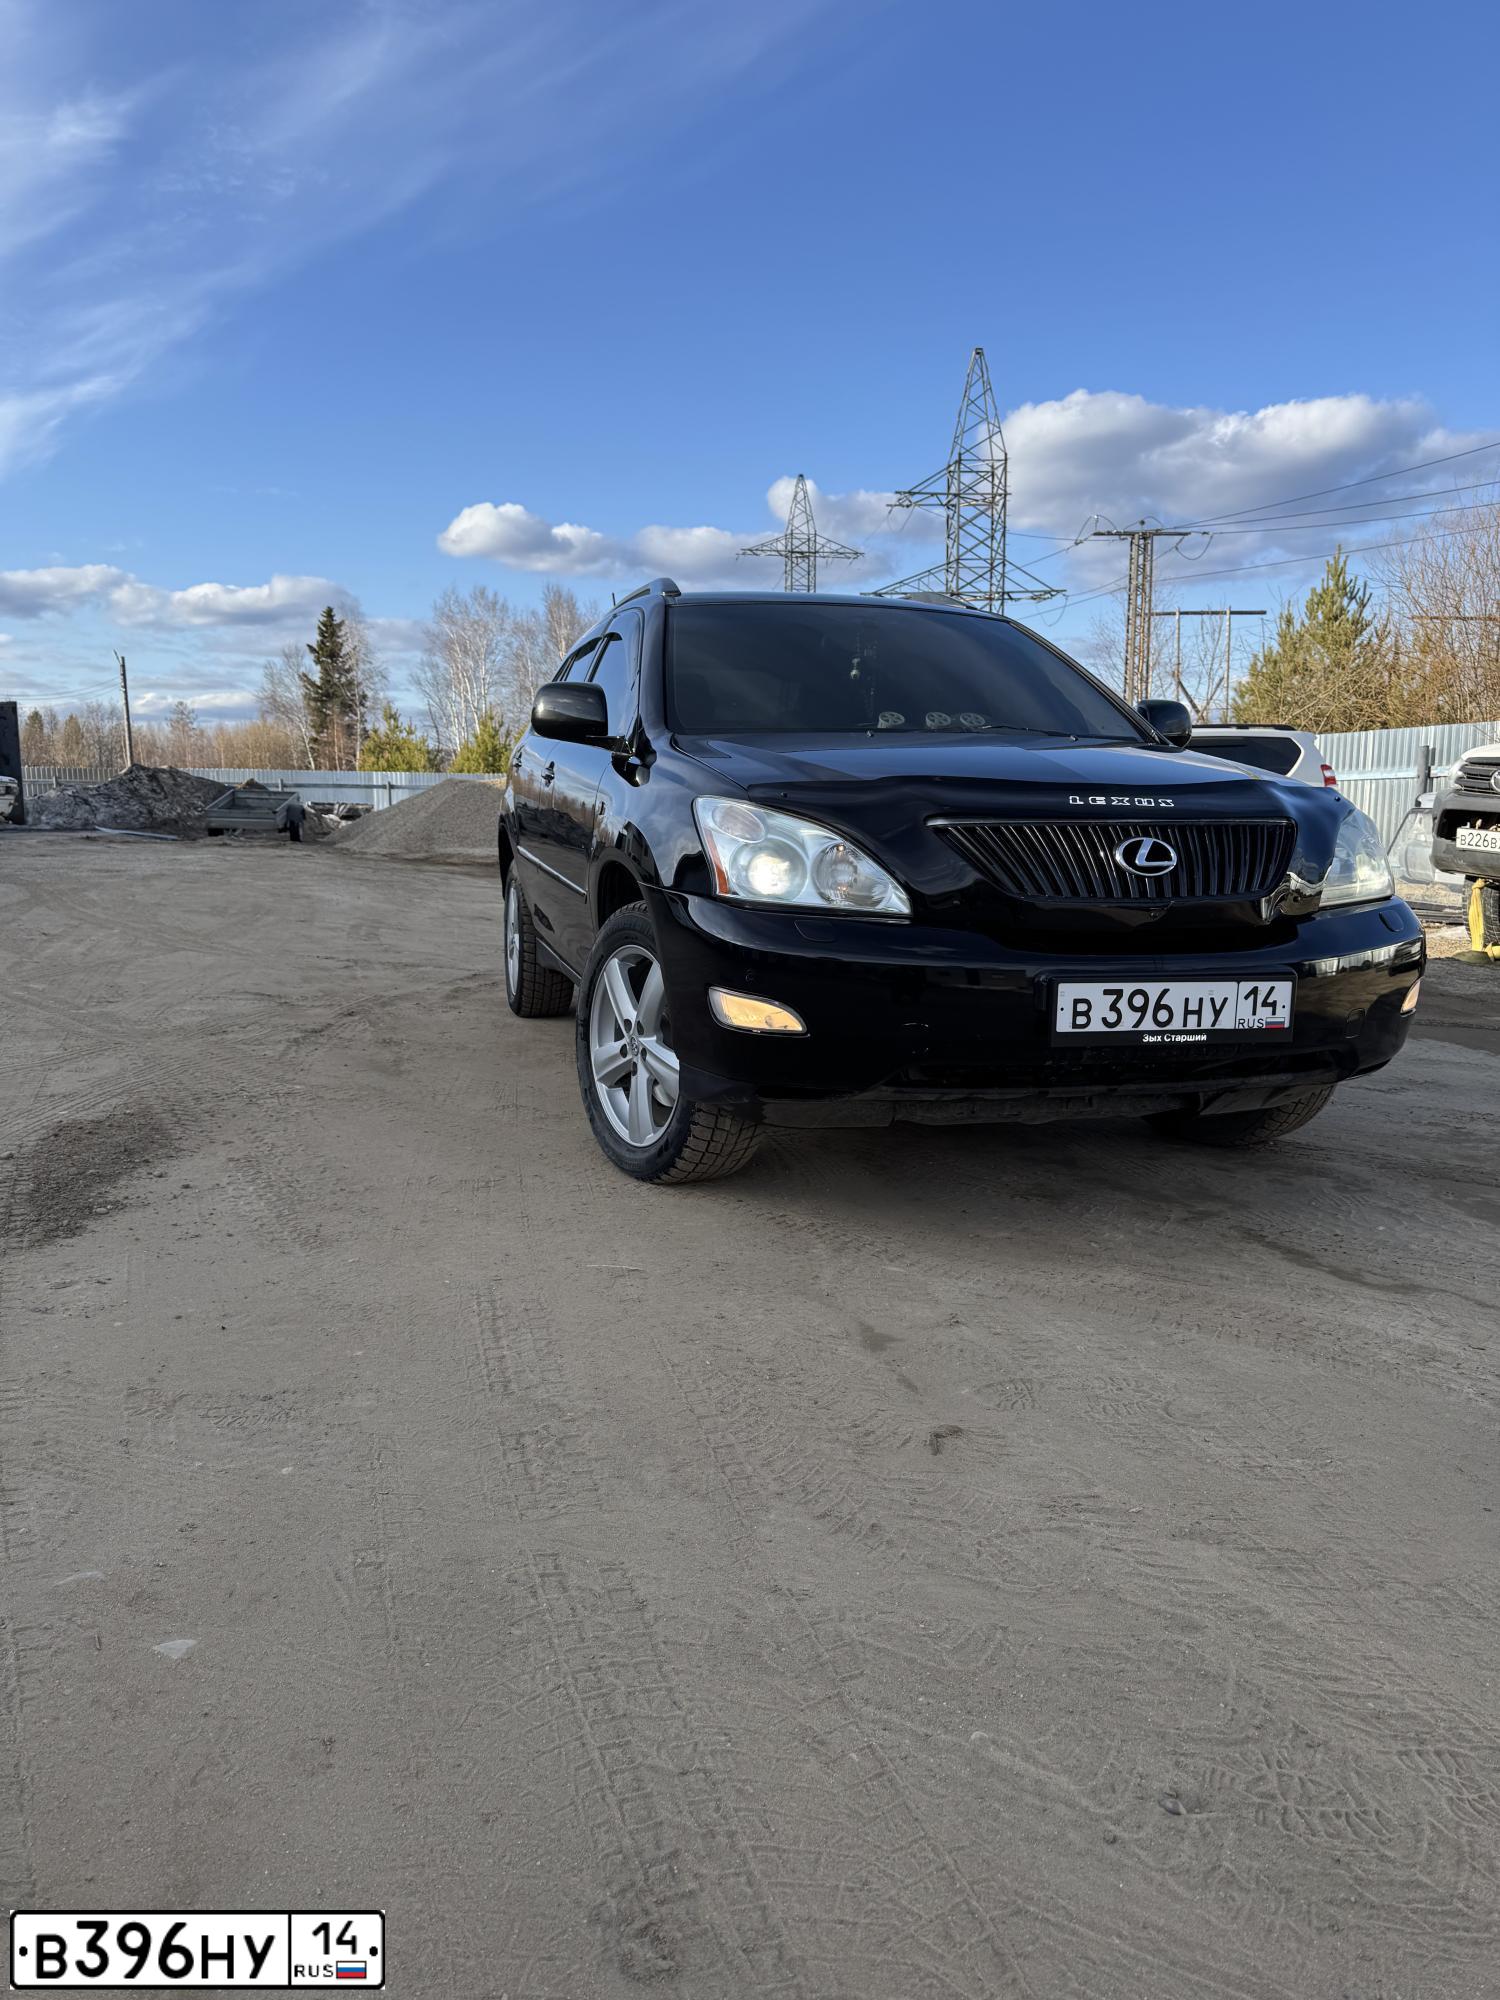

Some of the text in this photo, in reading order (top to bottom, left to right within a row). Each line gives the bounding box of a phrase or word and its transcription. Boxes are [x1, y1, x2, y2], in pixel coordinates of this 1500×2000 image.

[1069, 795, 1175, 807] LEXUS
[1460, 832, 1500, 849] В226В
[1071, 985, 1278, 1029] В396НУ 14
[1237, 1018, 1265, 1029] RUS
[1142, 1033, 1207, 1043] Зых Старший
